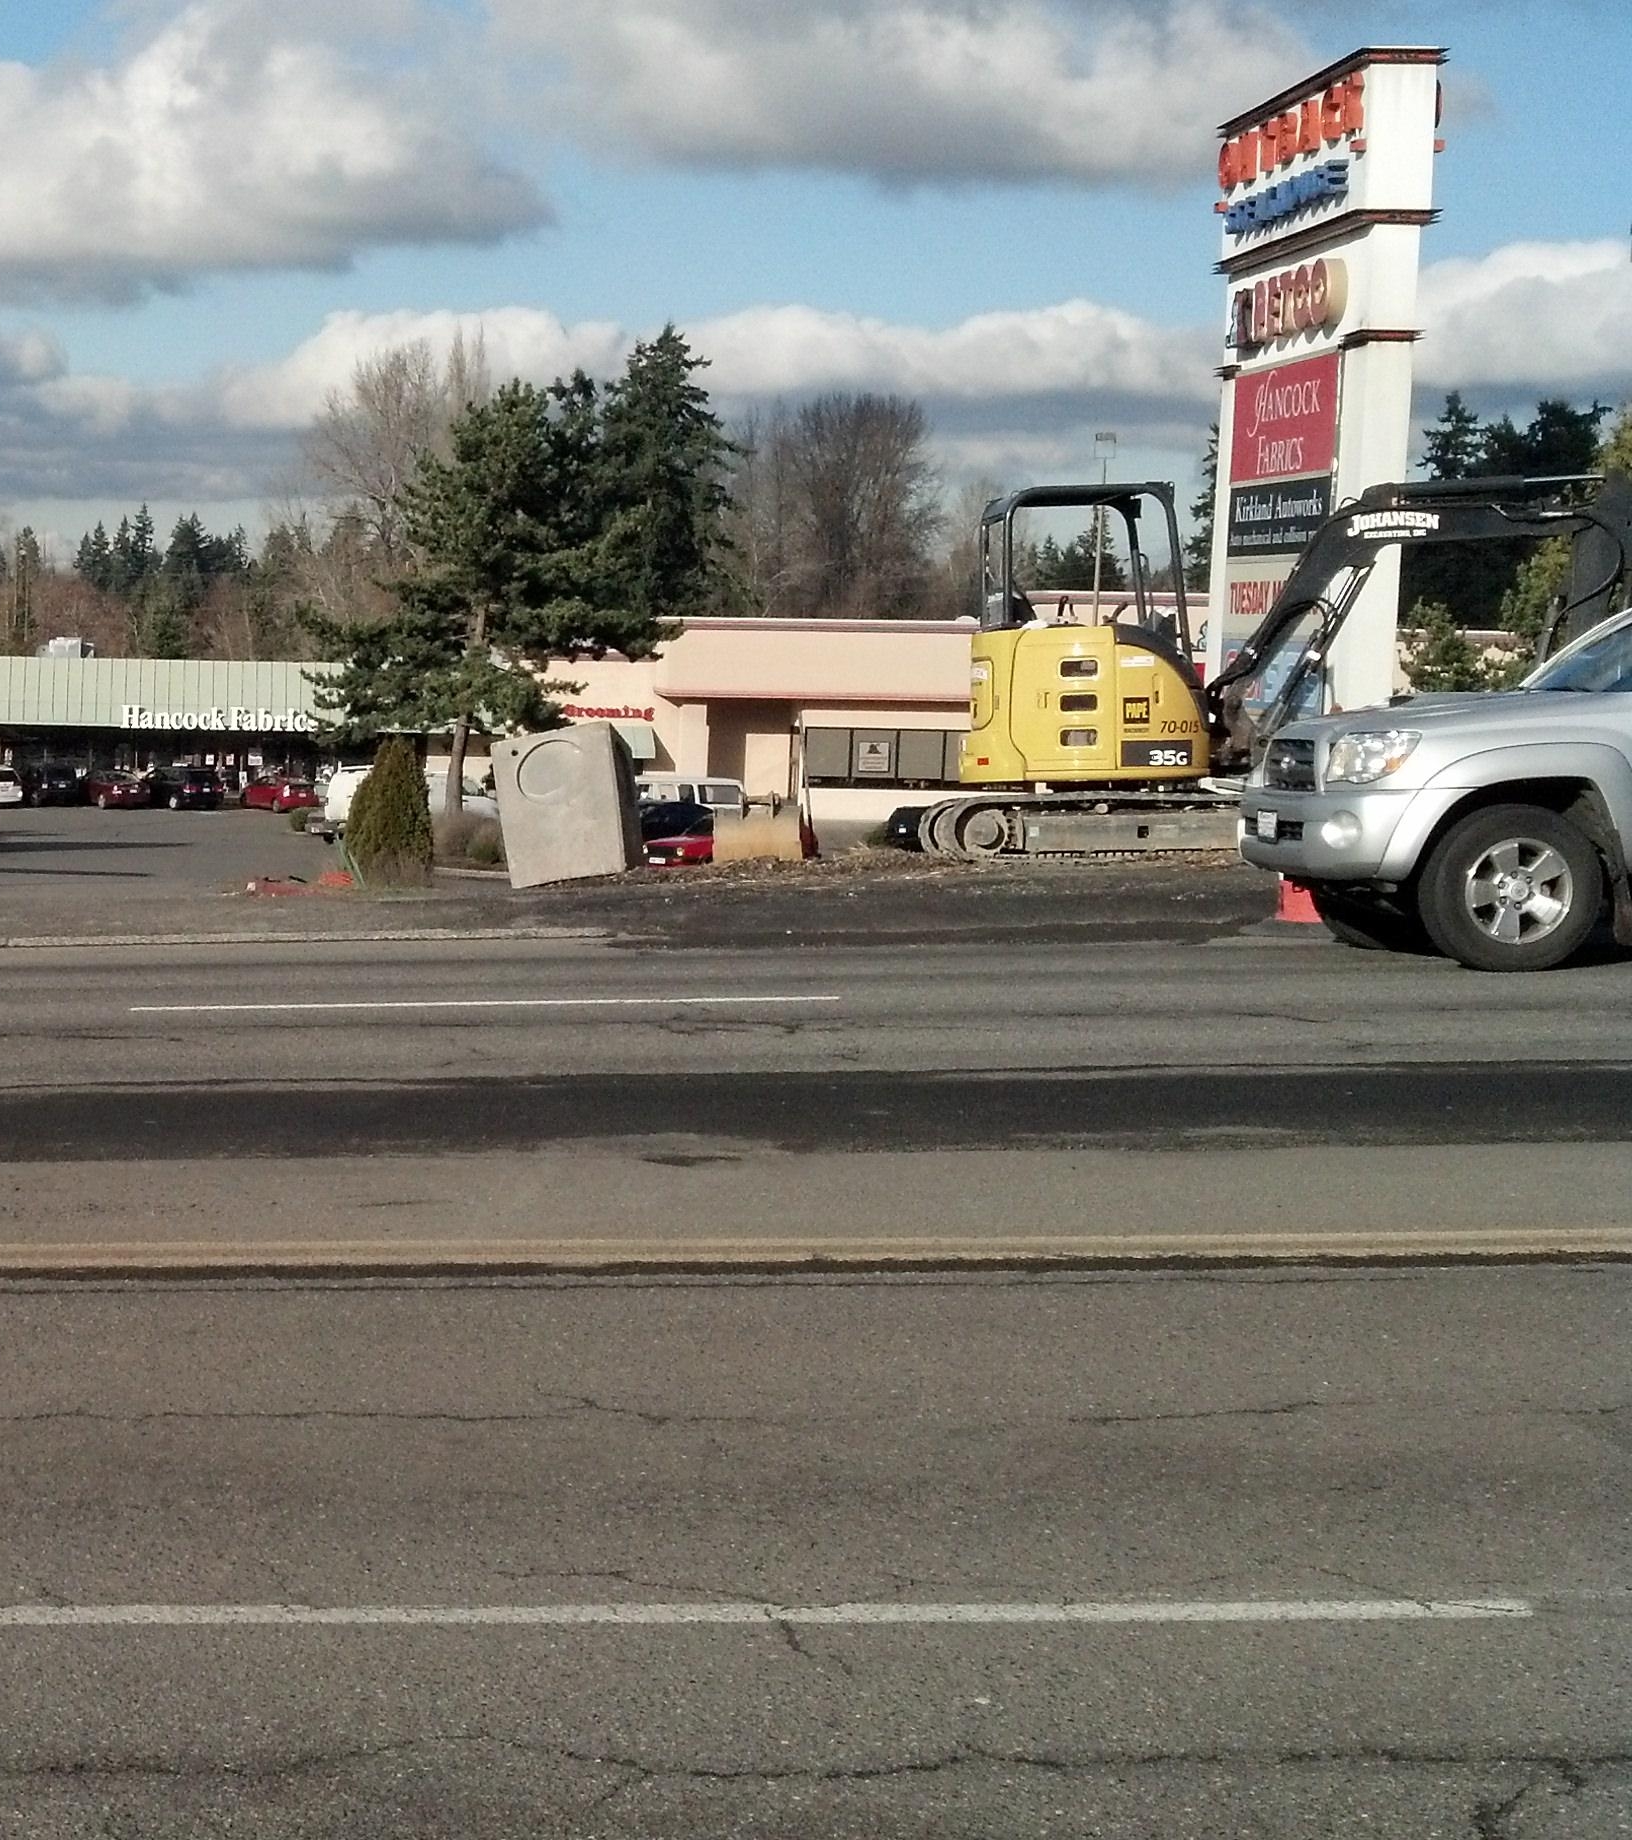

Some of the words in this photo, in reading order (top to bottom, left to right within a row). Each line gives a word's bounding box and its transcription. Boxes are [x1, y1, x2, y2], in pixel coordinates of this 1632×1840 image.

[1252, 260, 1347, 342] PETCO
[1247, 371, 1320, 437] HANCOCK
[1256, 435, 1304, 475] FABRICS
[1234, 493, 1273, 523] Kirkland
[1274, 488, 1323, 519] Autoworks
[1347, 511, 1440, 537] JOHANSEN
[1230, 580, 1270, 615] TUESDAY
[120, 704, 227, 731] Hancock
[1160, 720, 1200, 734] 70-015
[1149, 750, 1188, 766] 35G
